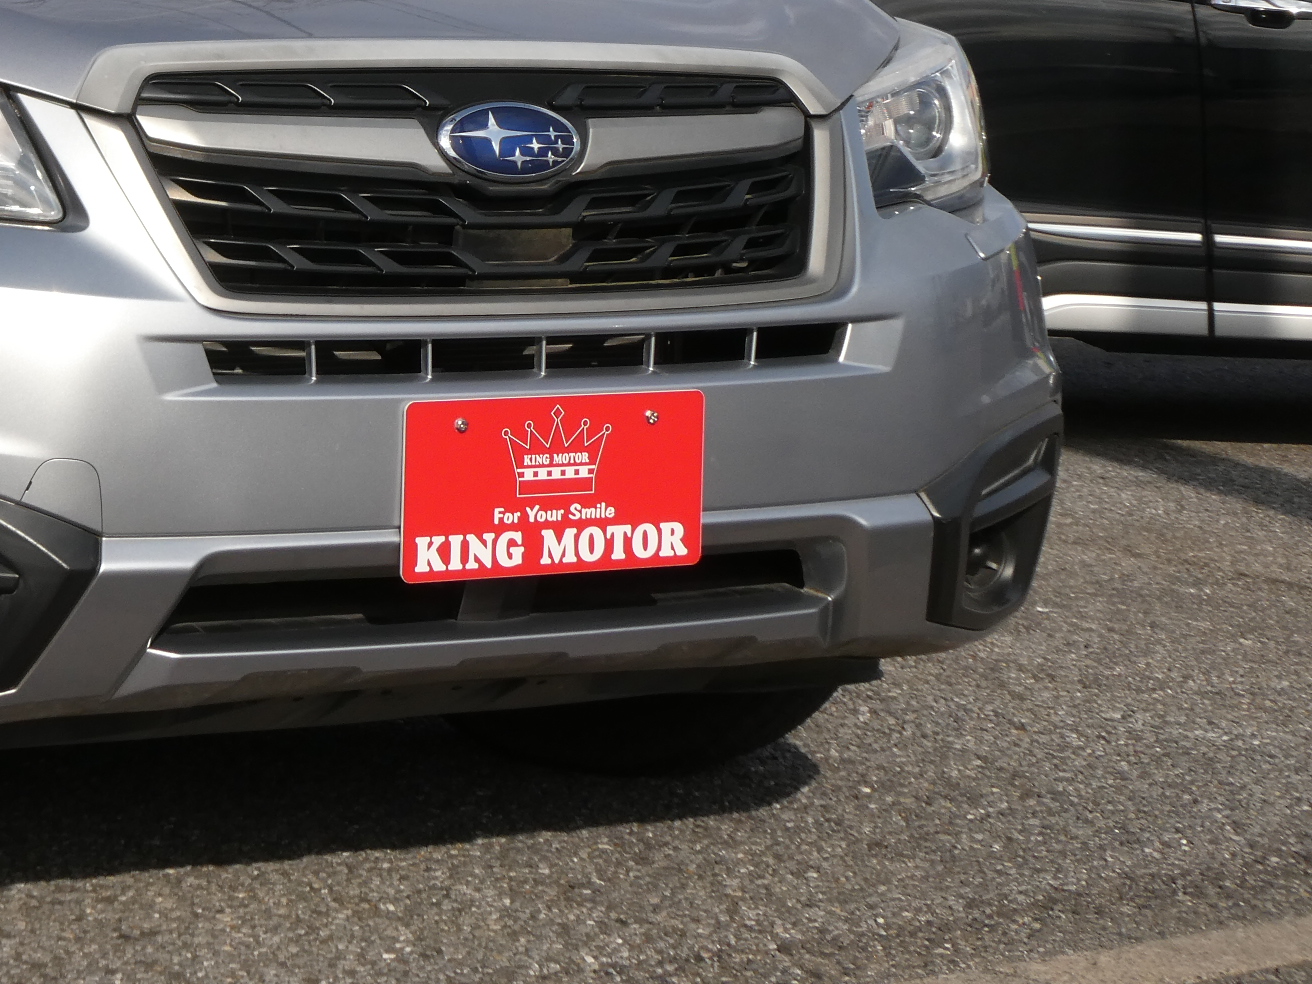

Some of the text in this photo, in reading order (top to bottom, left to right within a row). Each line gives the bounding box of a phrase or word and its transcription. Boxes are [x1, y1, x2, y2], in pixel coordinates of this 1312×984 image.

[523, 451, 590, 466] KING MOTOR
[493, 502, 616, 525] For Your Smile
[414, 521, 688, 573] KING MOTOR
